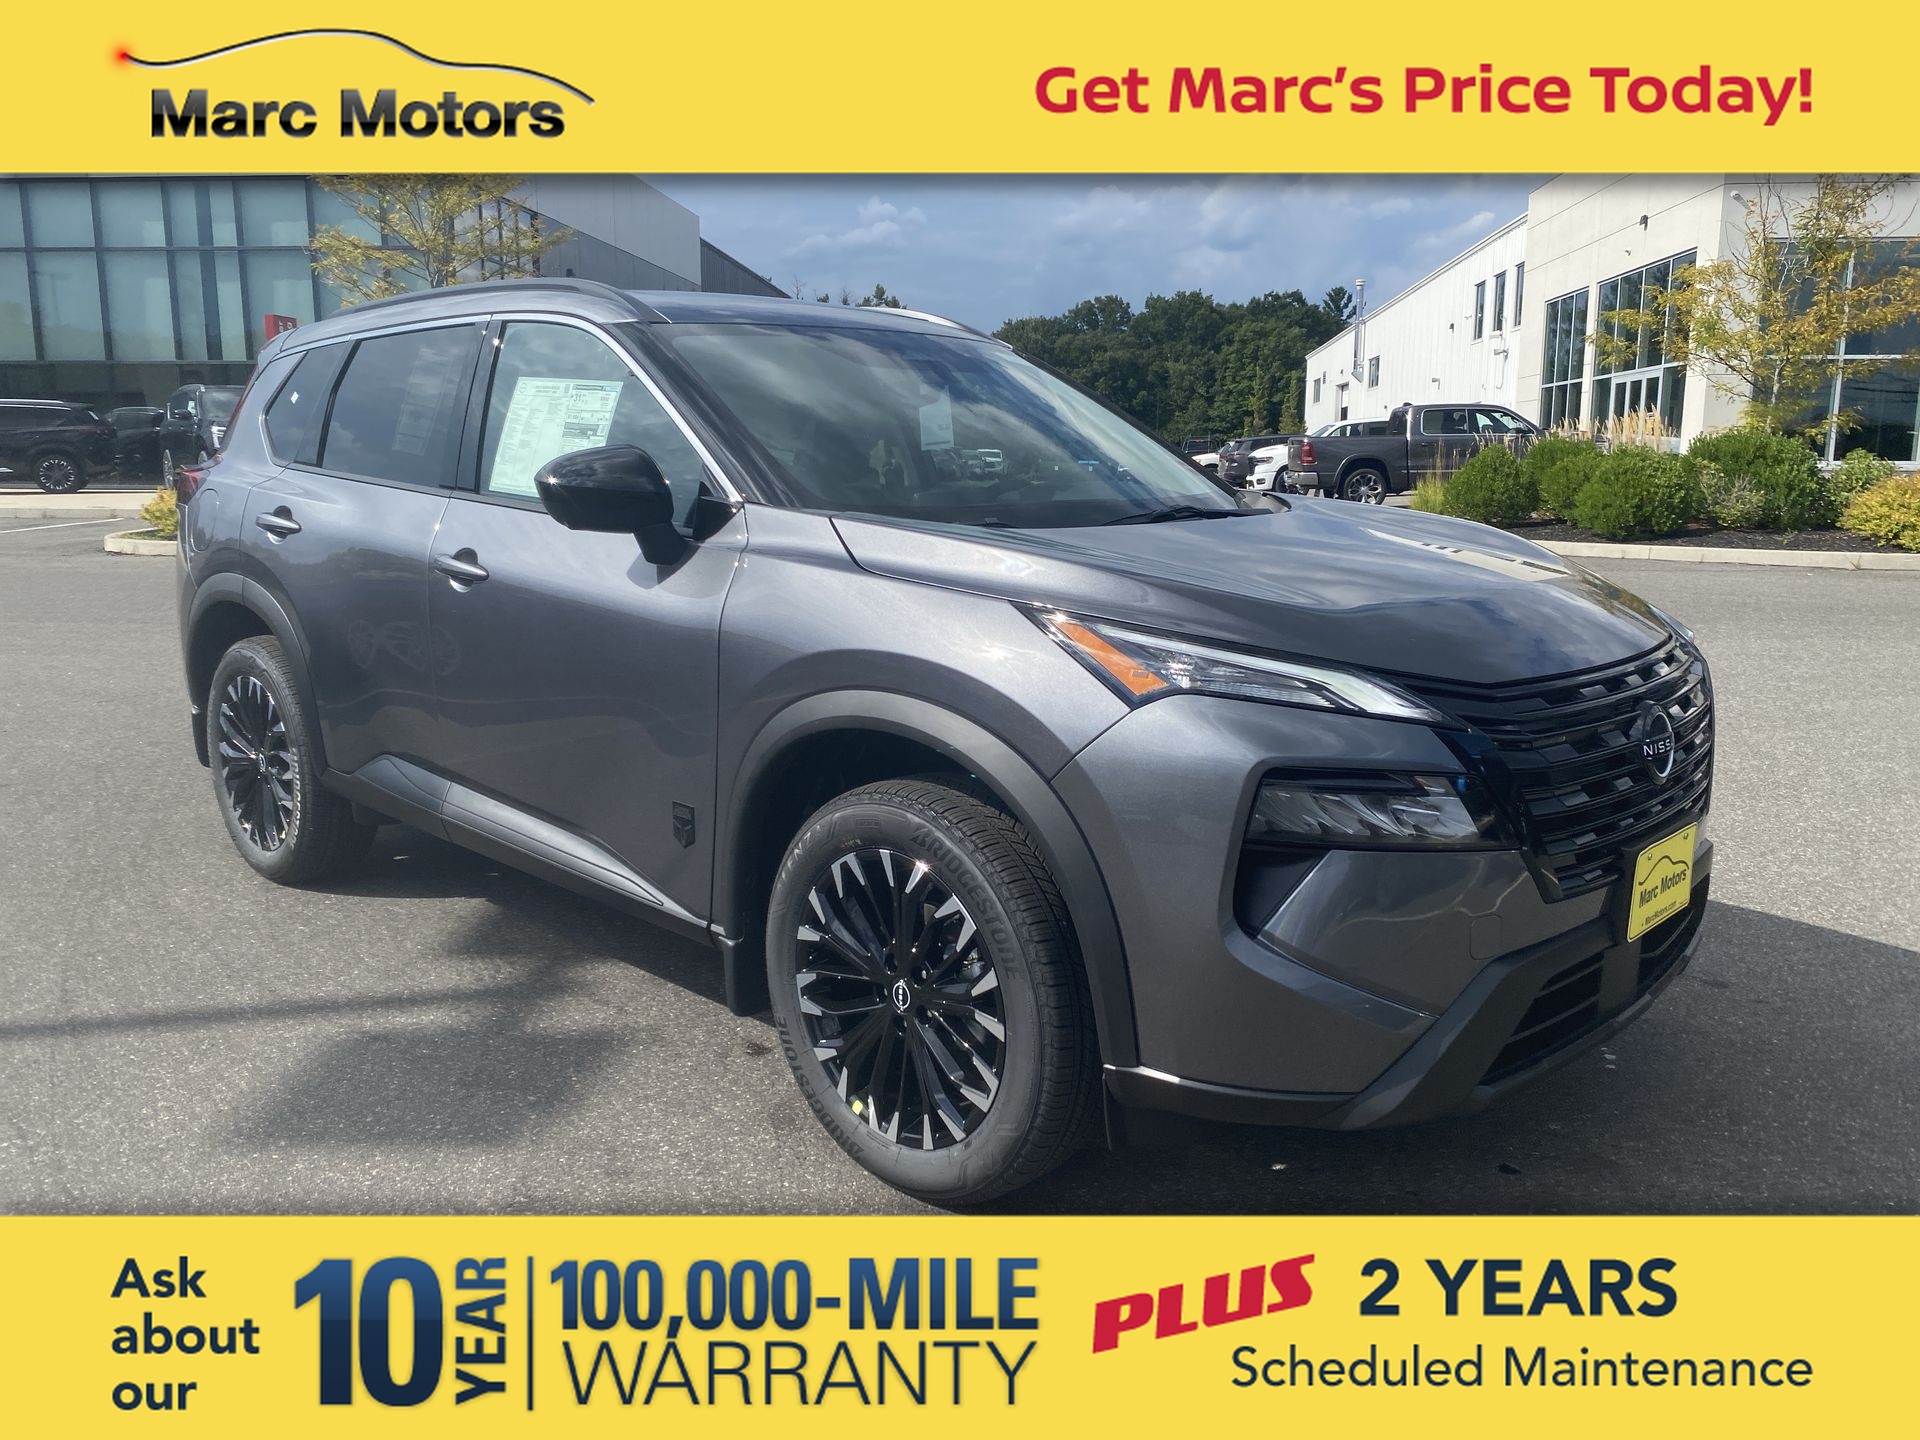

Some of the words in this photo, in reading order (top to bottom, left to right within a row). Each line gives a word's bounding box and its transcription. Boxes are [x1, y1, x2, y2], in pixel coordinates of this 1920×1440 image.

[1639, 886, 1659, 908] Marc
[1660, 869, 1687, 894] Motors
[776, 1015, 865, 1154] BRIDGESTONE
